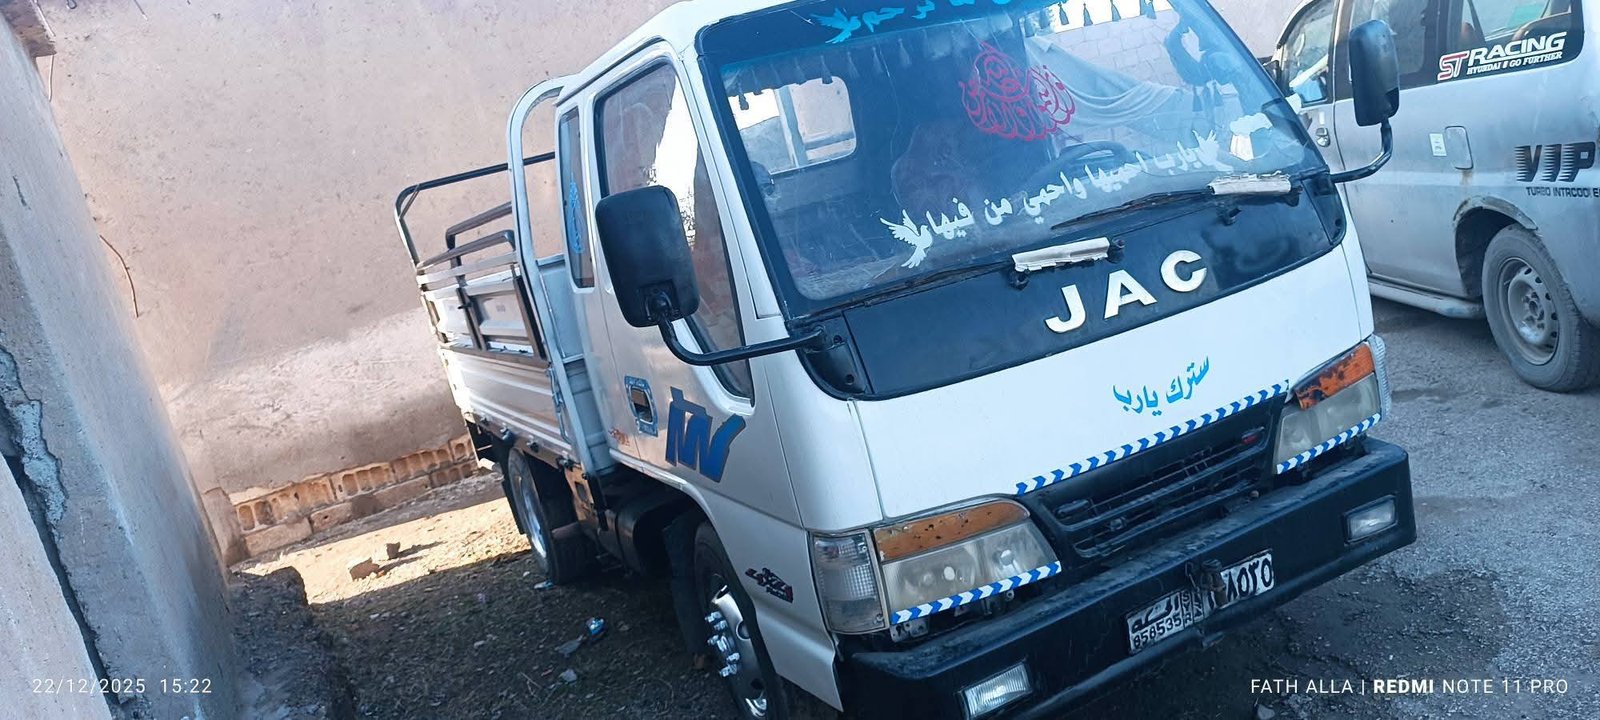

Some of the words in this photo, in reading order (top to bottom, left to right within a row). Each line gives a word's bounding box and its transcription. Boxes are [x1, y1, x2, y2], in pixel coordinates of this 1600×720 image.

[1467, 31, 1567, 67] RACING
[1509, 59, 1522, 68] GO
[1522, 51, 1563, 66] FURTHER
[1514, 141, 1596, 182] VIP
[926, 197, 975, 240] فيها
[984, 198, 1014, 225] من
[1045, 250, 1208, 333] JAC
[1165, 355, 1209, 404] سترك
[1113, 384, 1162, 416] يارب
[1133, 611, 1182, 649] 858535
